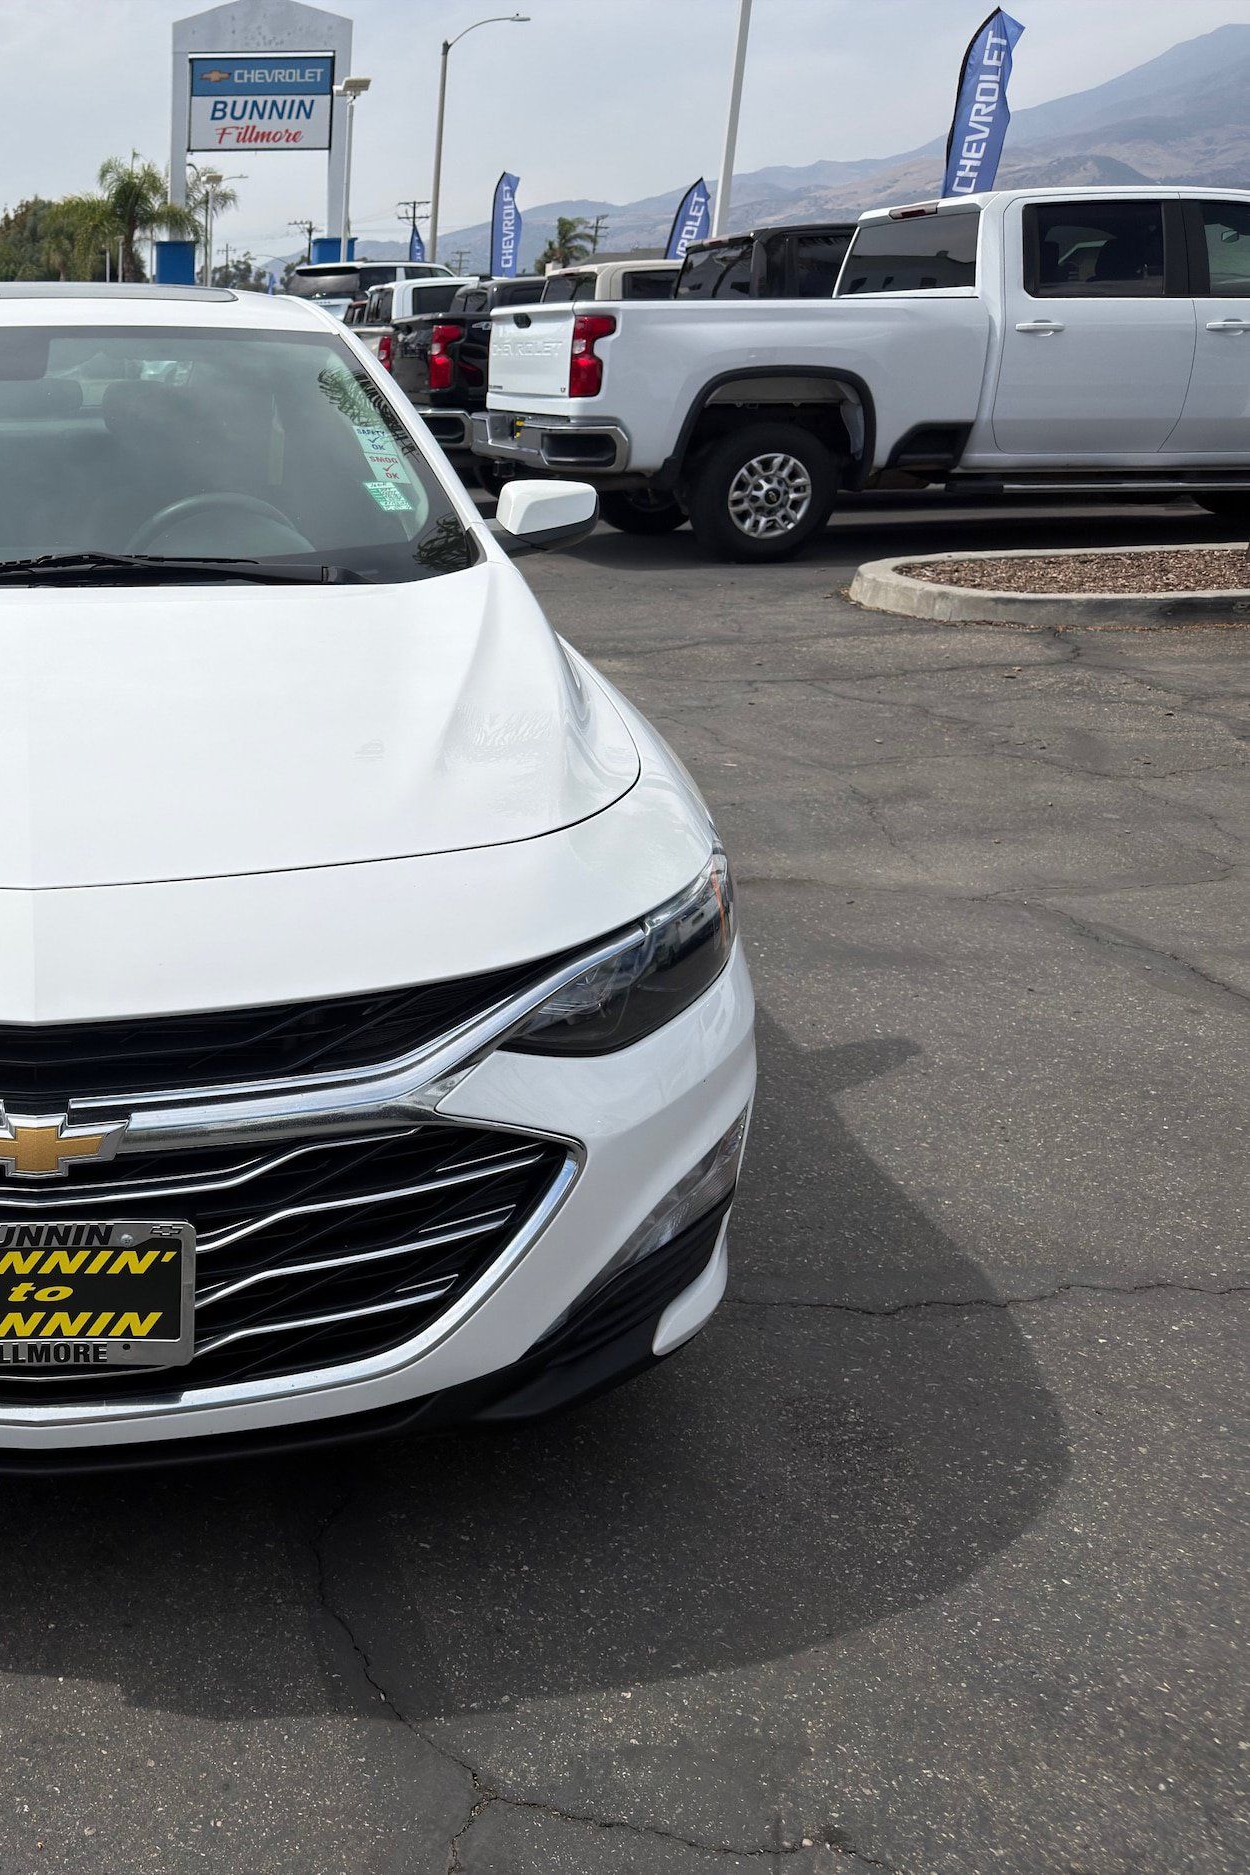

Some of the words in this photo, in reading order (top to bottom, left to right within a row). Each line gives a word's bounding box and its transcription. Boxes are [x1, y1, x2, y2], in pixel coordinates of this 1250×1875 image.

[234, 68, 324, 83] CHEVROLET
[210, 99, 315, 121] BUNNIN
[952, 30, 1007, 194] CHEVROLET
[215, 124, 304, 144] Fillmore
[356, 428, 385, 437] SAFETY
[371, 443, 386, 451] OK
[369, 456, 399, 464] SMOG
[385, 472, 400, 480] OK
[8, 1282, 74, 1302] to
